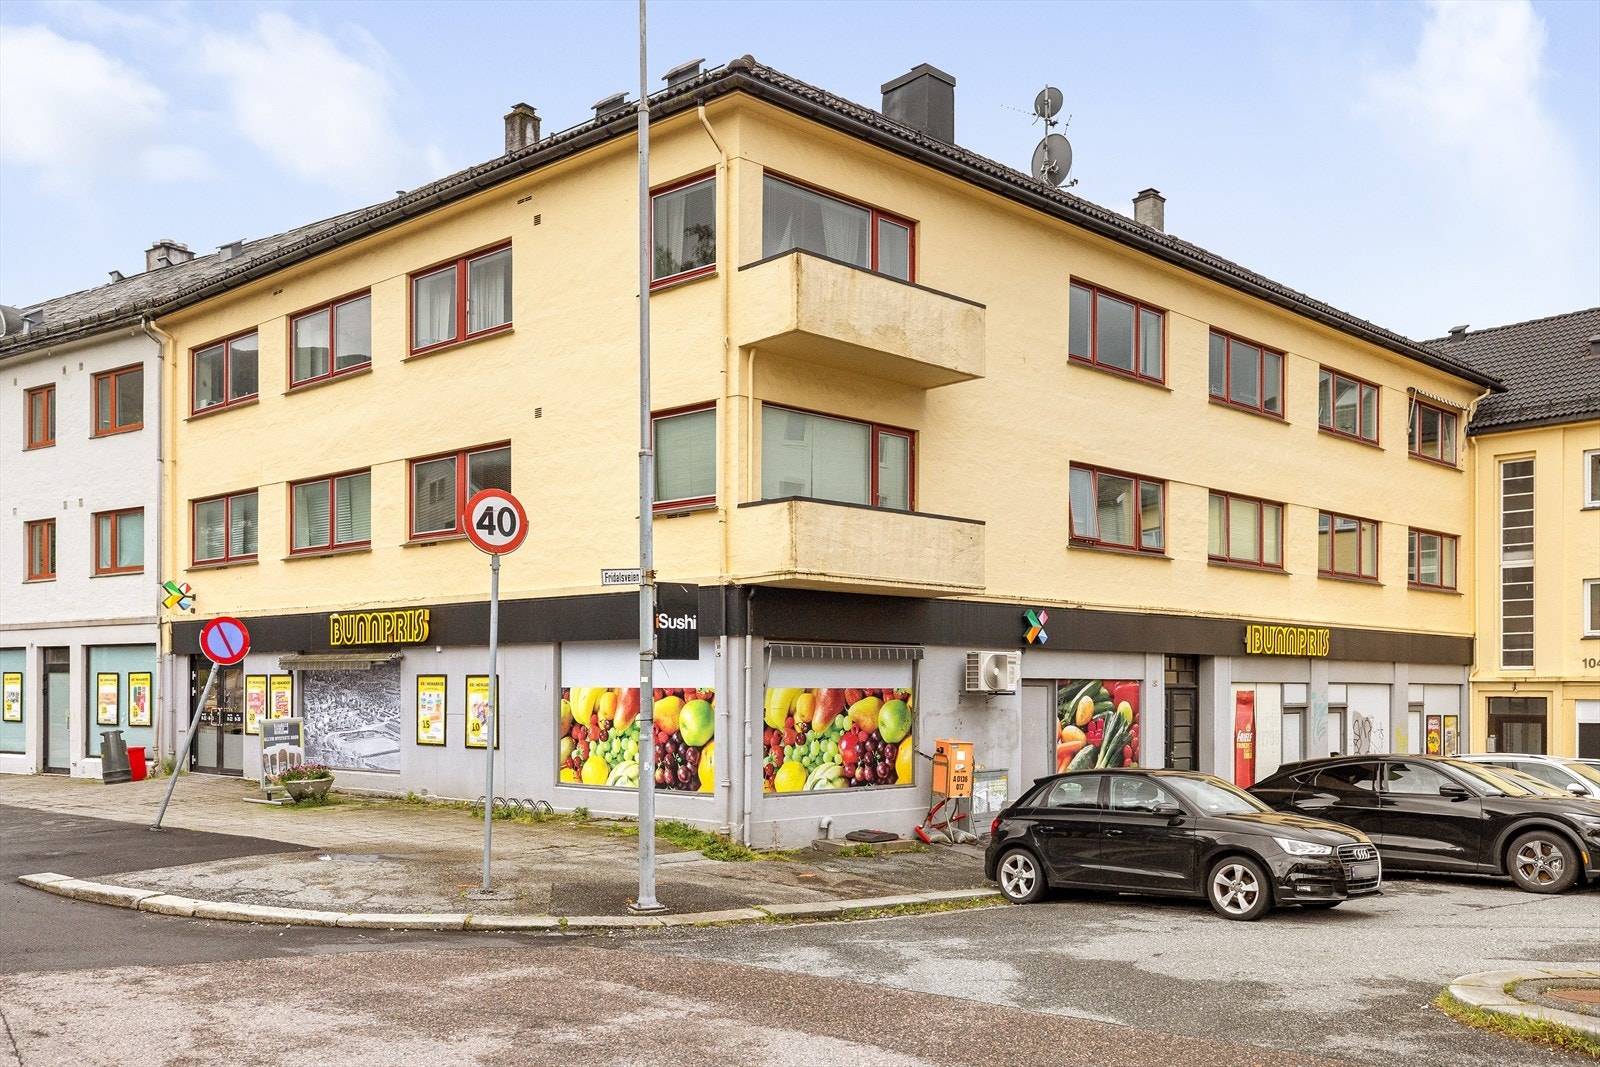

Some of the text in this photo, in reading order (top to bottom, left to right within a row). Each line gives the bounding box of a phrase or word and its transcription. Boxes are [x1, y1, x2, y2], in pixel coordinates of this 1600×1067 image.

[476, 505, 516, 537] 40
[330, 609, 430, 645] BUNNPRIS
[655, 613, 697, 630] iSushi
[1247, 624, 1330, 657] BUNNPRIS
[422, 720, 430, 729] 15
[472, 723, 480, 731] 10
